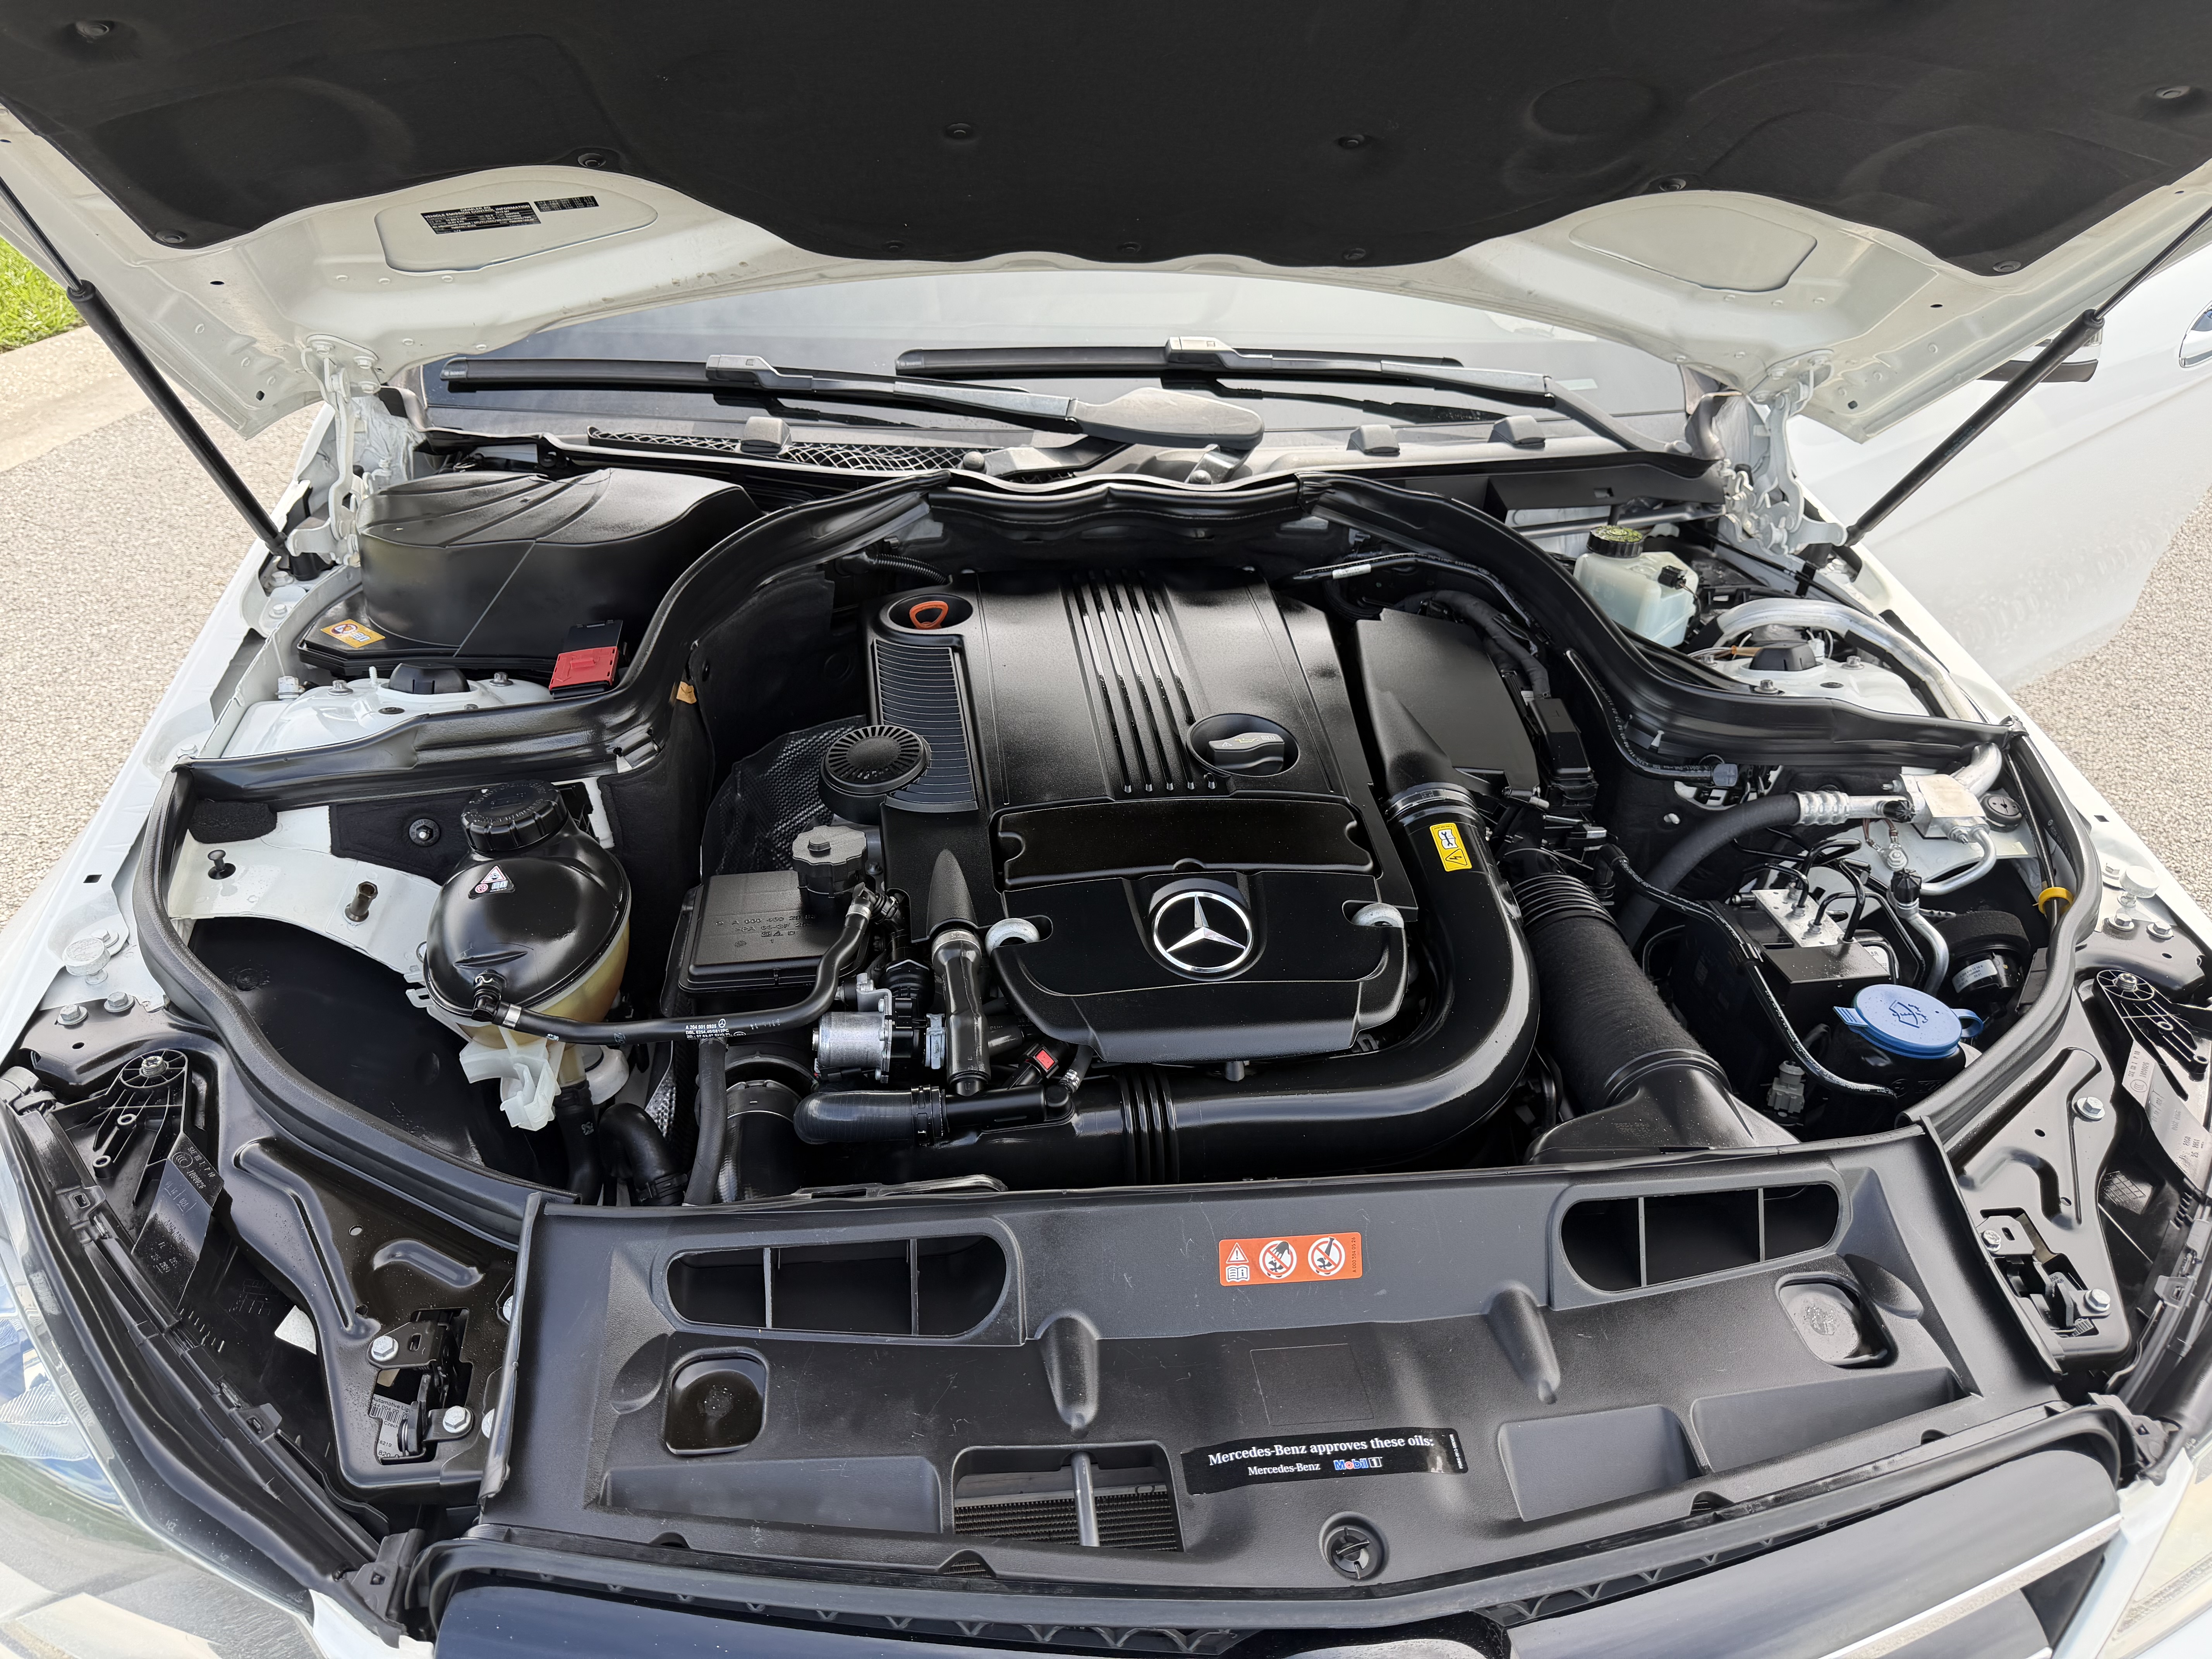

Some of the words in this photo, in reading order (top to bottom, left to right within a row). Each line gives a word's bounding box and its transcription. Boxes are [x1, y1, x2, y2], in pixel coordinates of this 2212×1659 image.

[373, 1396, 400, 1409] Automotive
[1208, 1444, 1307, 1466] Mercedes-Benz
[1310, 1441, 1367, 1455] approves
[1370, 1437, 1405, 1449] these
[1408, 1435, 1434, 1446] oils:
[1247, 1463, 1321, 1475] Mercedes-Benz
[1333, 1458, 1369, 1470] Mobil
